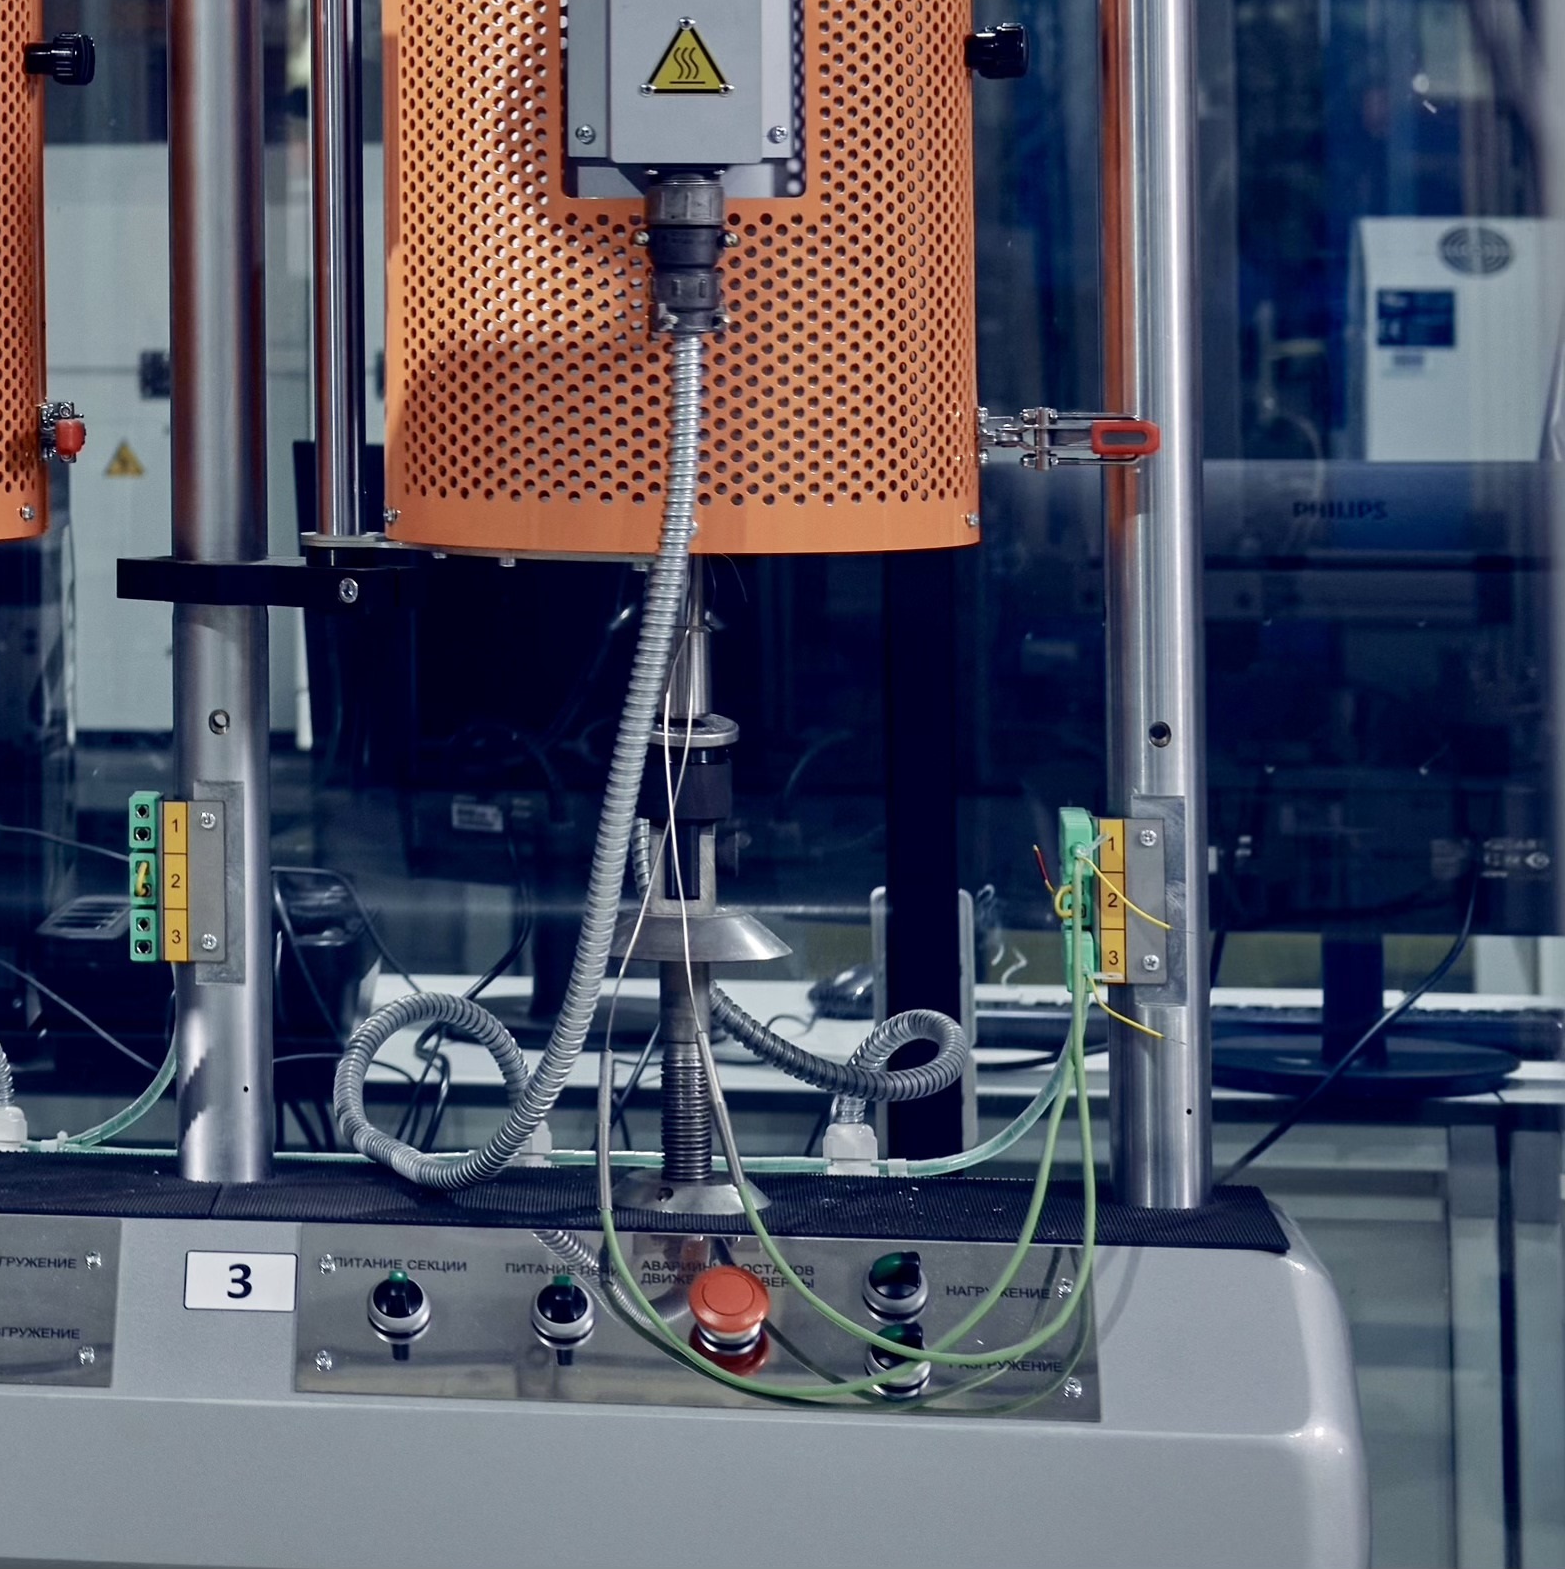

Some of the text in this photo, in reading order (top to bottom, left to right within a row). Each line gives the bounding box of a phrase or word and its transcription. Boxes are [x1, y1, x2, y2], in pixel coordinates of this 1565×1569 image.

[172, 818, 179, 833] 1
[1108, 836, 1115, 851] 1
[171, 873, 181, 889] 2
[1107, 892, 1118, 908] 2
[171, 929, 181, 944] 3
[1108, 950, 1119, 966] 3
[334, 1256, 467, 1273] ПИТАНИЕ СЕКЦИИ
[505, 1262, 576, 1276] ПИТАНИЕ
[227, 1263, 253, 1299] 3
